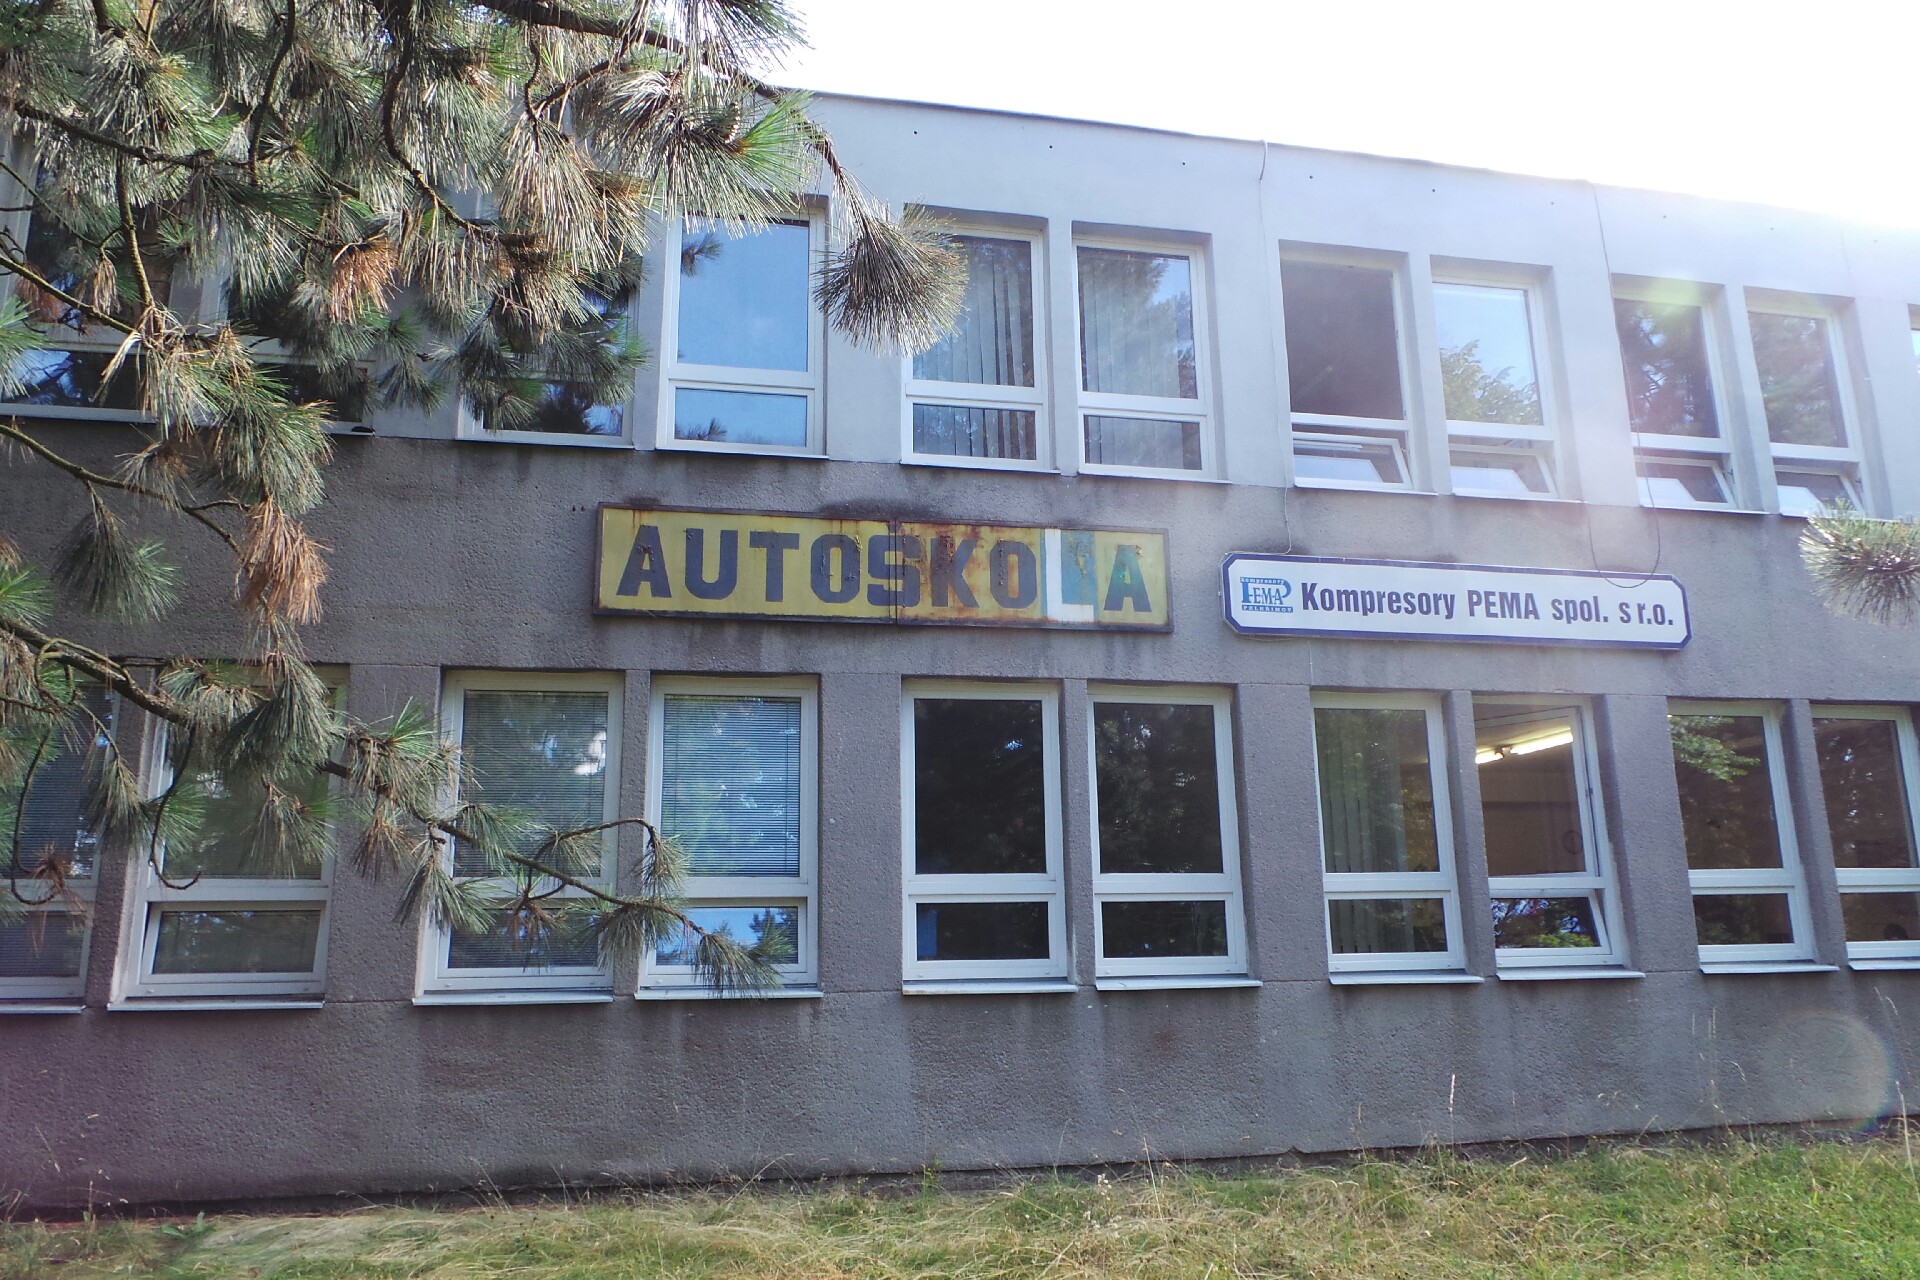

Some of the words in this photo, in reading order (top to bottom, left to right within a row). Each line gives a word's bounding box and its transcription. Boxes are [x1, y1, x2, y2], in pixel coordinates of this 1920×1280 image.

[616, 522, 1152, 622] AUTOŠKOLA
[1301, 581, 1456, 619] Kompresory
[1467, 589, 1541, 620] PEMA
[1552, 595, 1609, 624] spol.
